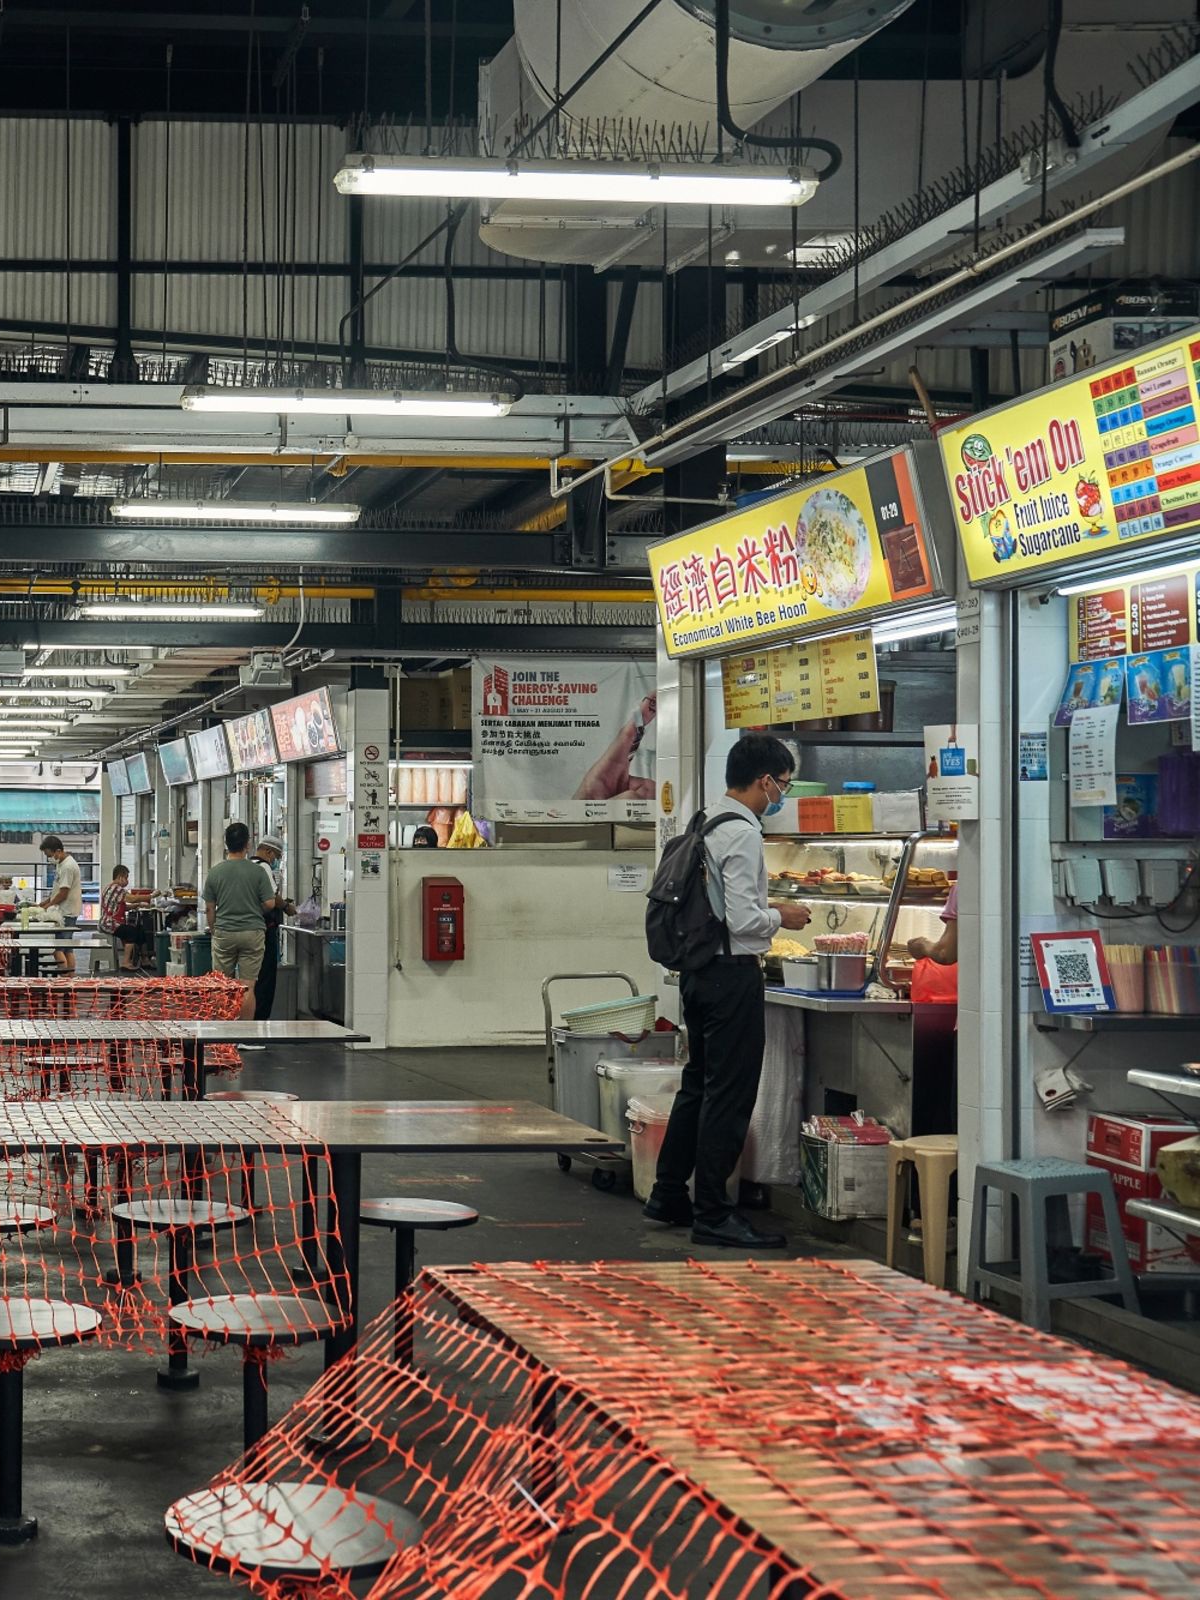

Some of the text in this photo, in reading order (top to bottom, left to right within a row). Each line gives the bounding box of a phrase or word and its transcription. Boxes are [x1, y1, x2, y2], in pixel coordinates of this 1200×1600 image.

[955, 455, 1009, 523] Stick
[1049, 418, 1085, 473] On
[1013, 493, 1069, 529] Fruit Juice
[1018, 522, 1081, 557] Sugarcane
[672, 602, 807, 647] Economical White Bee Hoon
[512, 671, 560, 682] JOIN THE
[512, 683, 598, 694] ENERGY-SAVING
[511, 695, 569, 706] CHALLENGE
[504, 720, 536, 728] CABARAN
[537, 720, 572, 728] MENJIMAT
[574, 720, 601, 728] TENAGA
[944, 758, 961, 766] YES
